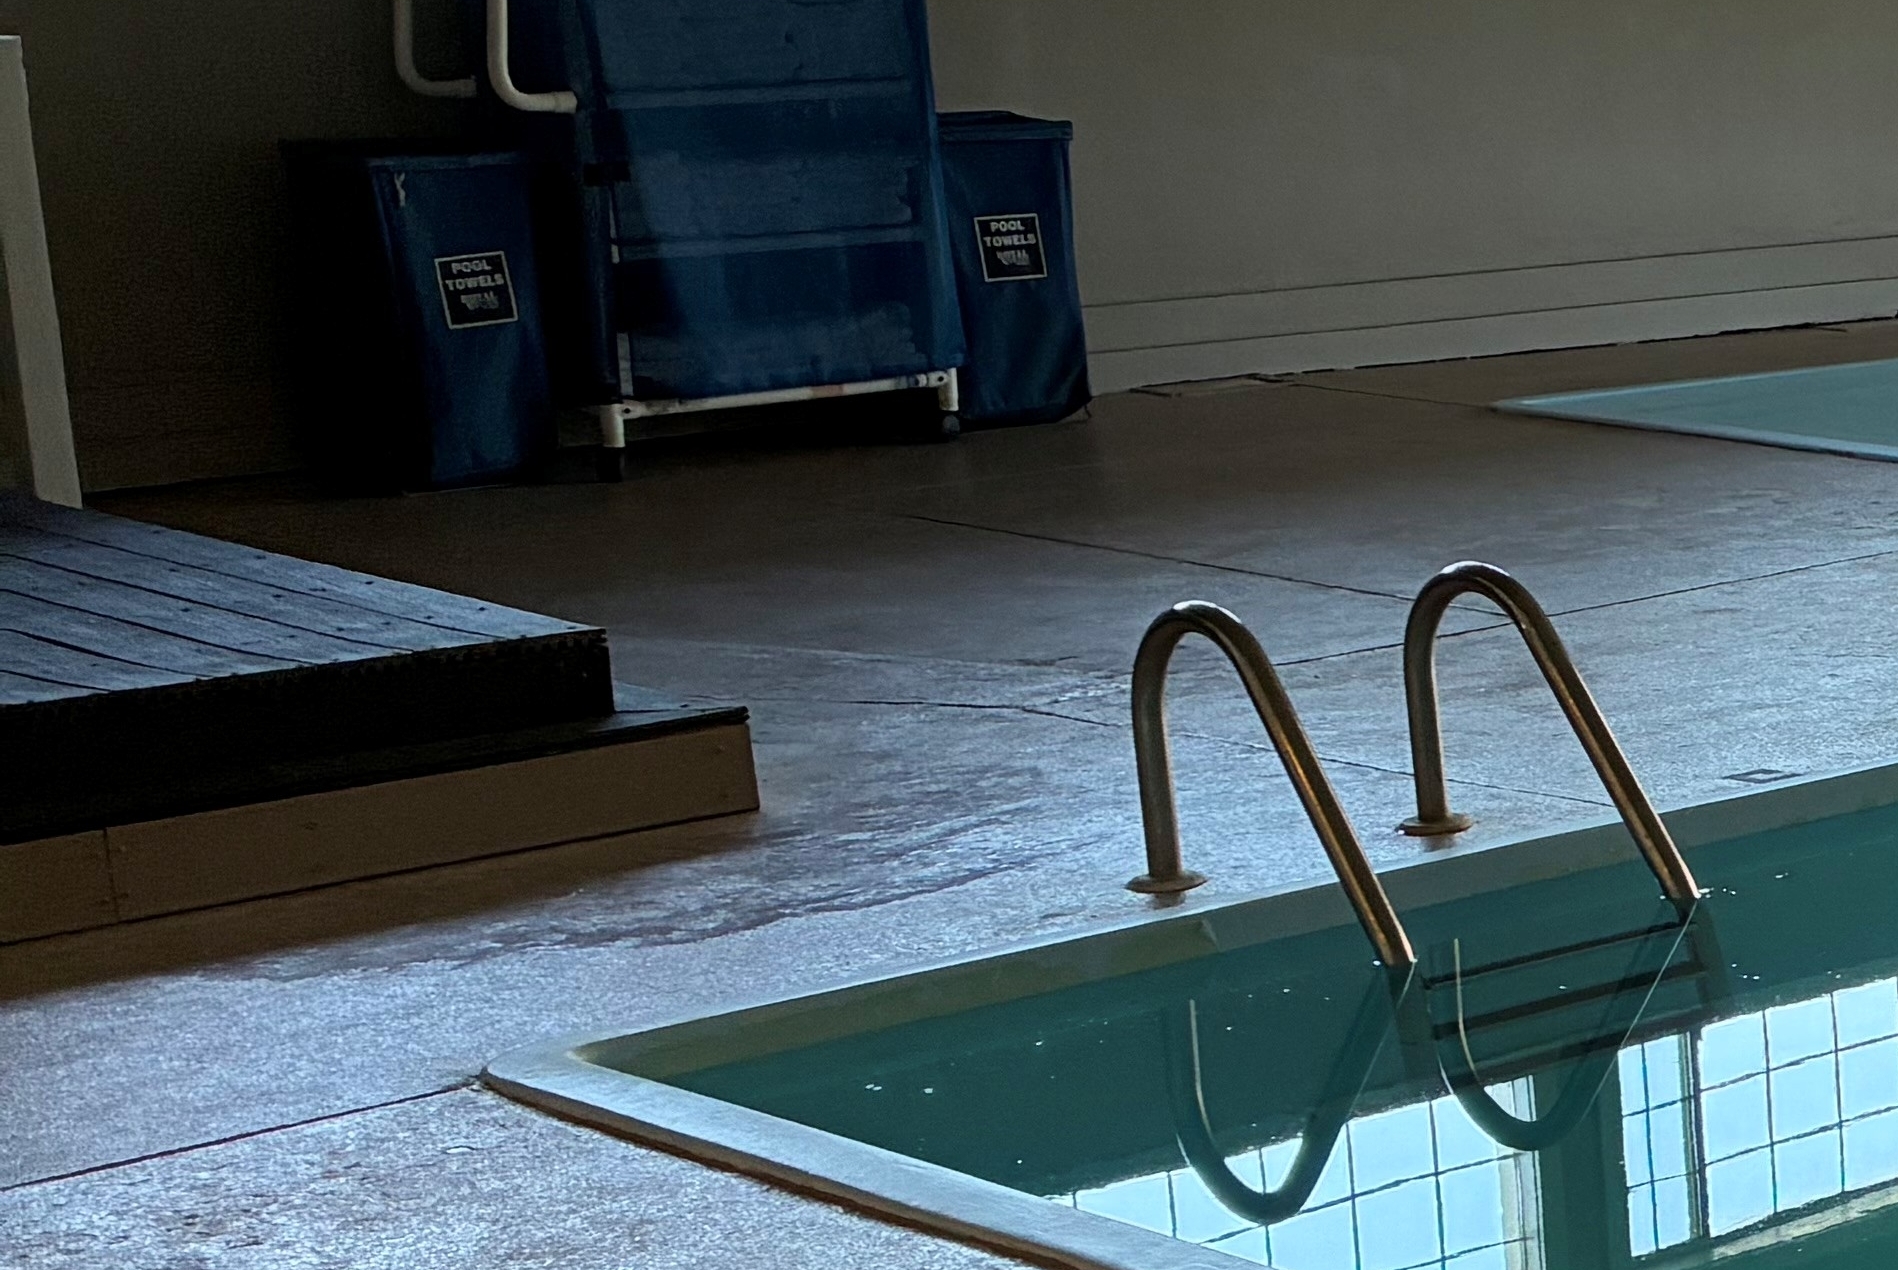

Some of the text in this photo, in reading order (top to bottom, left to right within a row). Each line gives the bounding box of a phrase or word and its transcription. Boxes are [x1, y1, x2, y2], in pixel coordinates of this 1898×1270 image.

[989, 220, 1025, 233] POOL
[983, 233, 1037, 248] TOWELS
[451, 259, 492, 274] POOL
[445, 273, 504, 291] TOWELS
